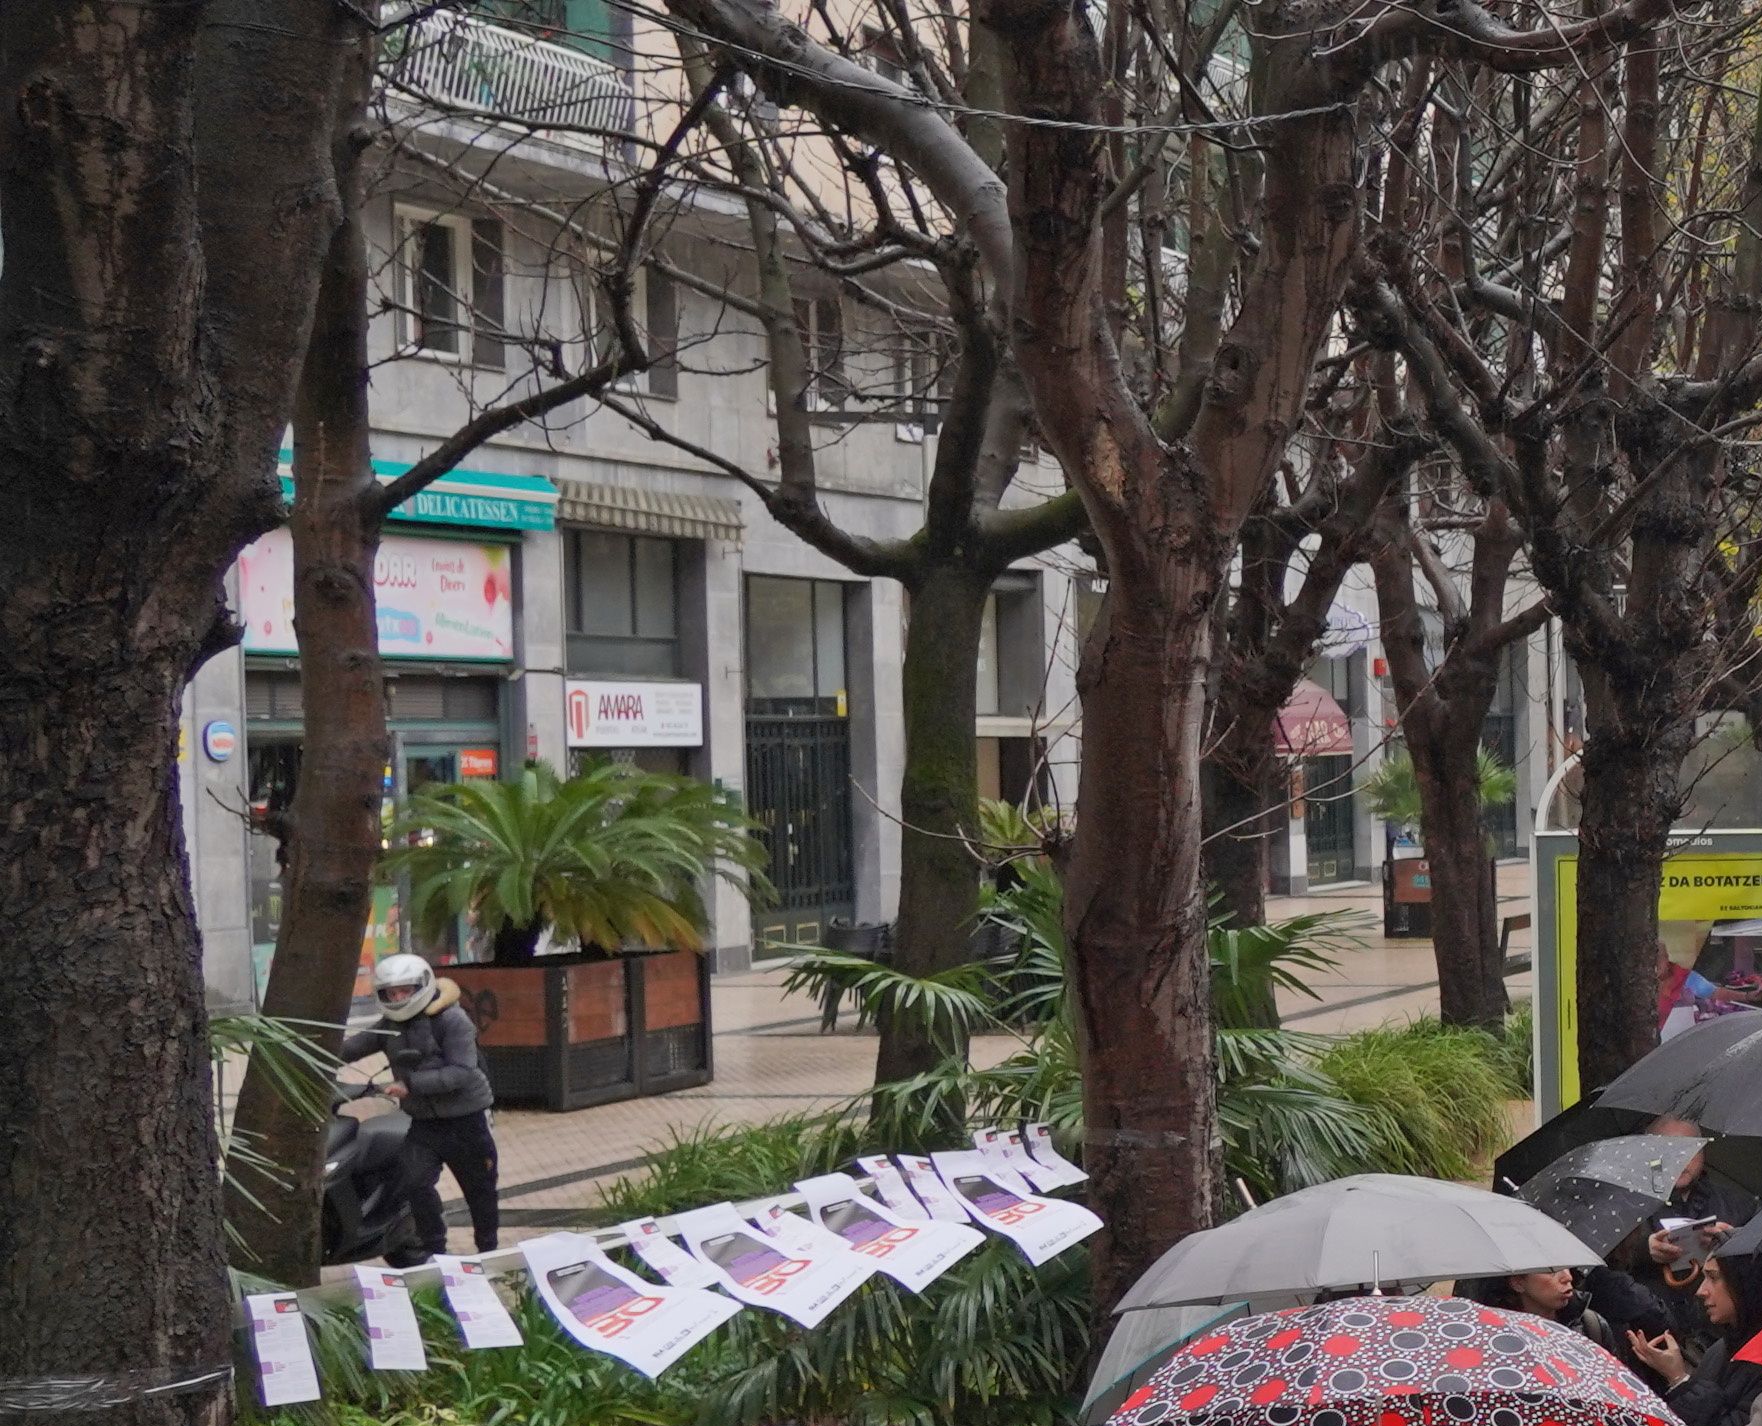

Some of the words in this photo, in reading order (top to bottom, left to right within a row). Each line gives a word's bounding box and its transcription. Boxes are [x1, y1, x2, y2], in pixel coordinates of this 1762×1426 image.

[418, 495, 518, 522] DELICATESSEN
[598, 694, 644, 720] AMARA
[1669, 876, 1690, 888] DA
